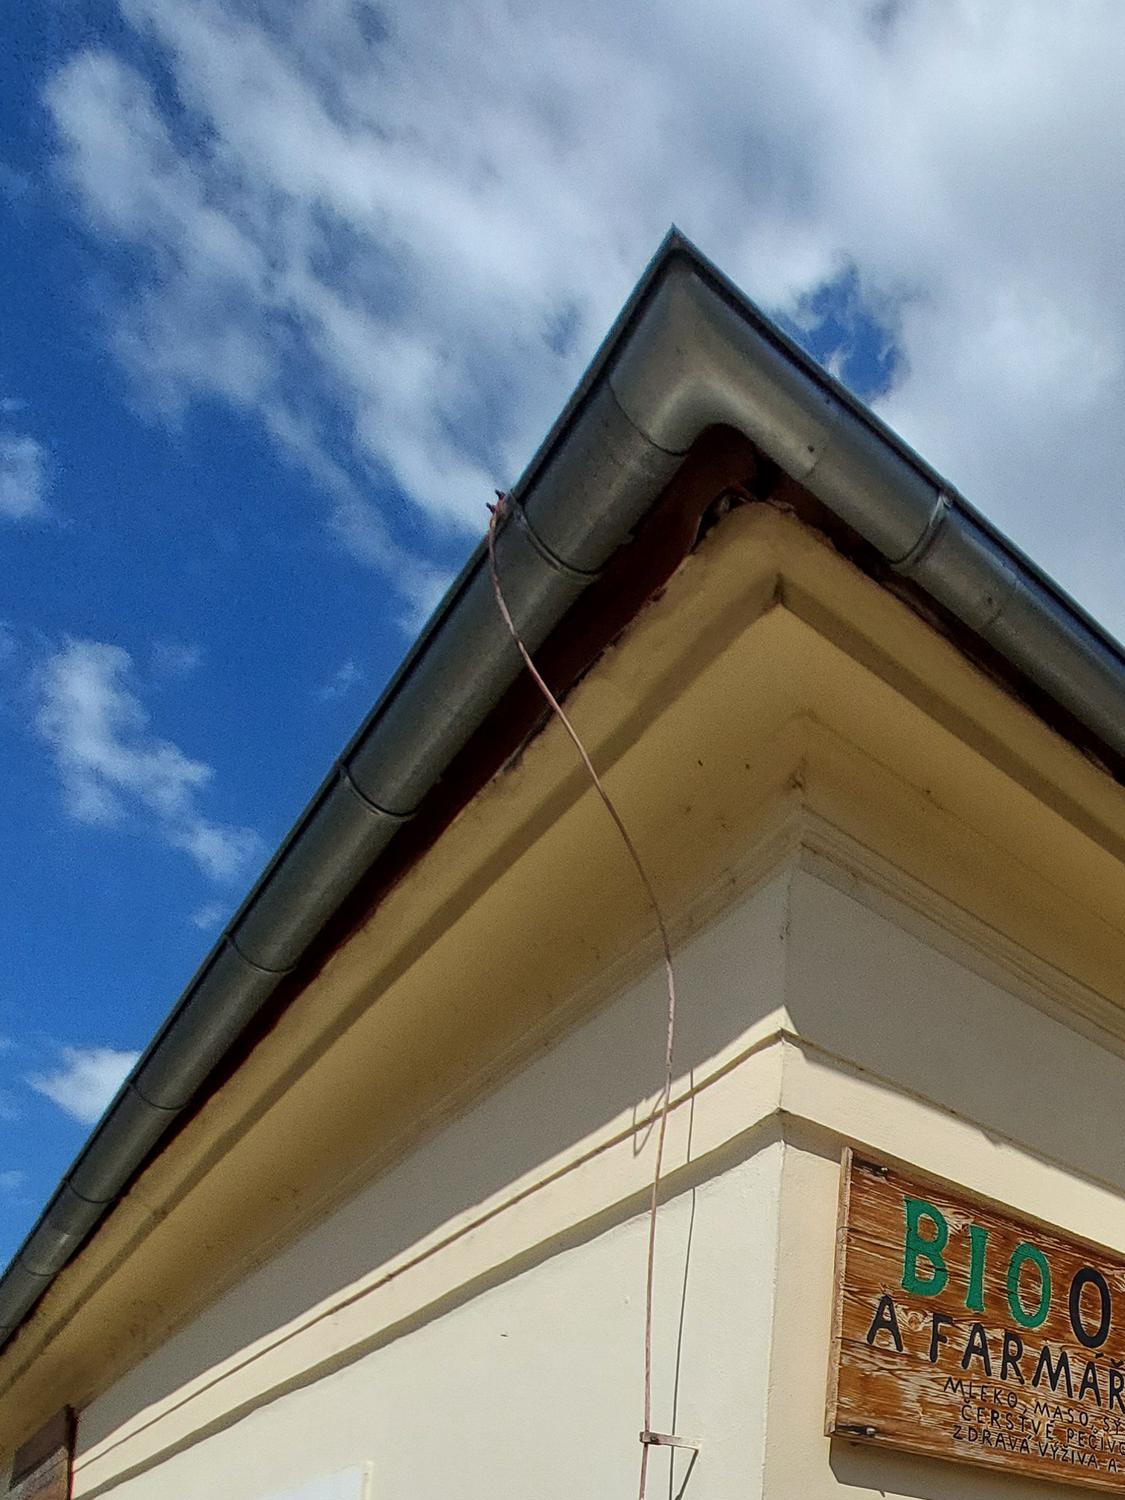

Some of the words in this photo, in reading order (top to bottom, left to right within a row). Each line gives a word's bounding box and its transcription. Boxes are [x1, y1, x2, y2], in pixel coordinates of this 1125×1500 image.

[866, 1296, 904, 1352] A
[1034, 1401, 1094, 1430] MASO,
[953, 1425, 1031, 1454] ZDRAVÁ
[1038, 1442, 1099, 1469] VÝŽIVA
[1108, 1458, 1118, 1473] A
